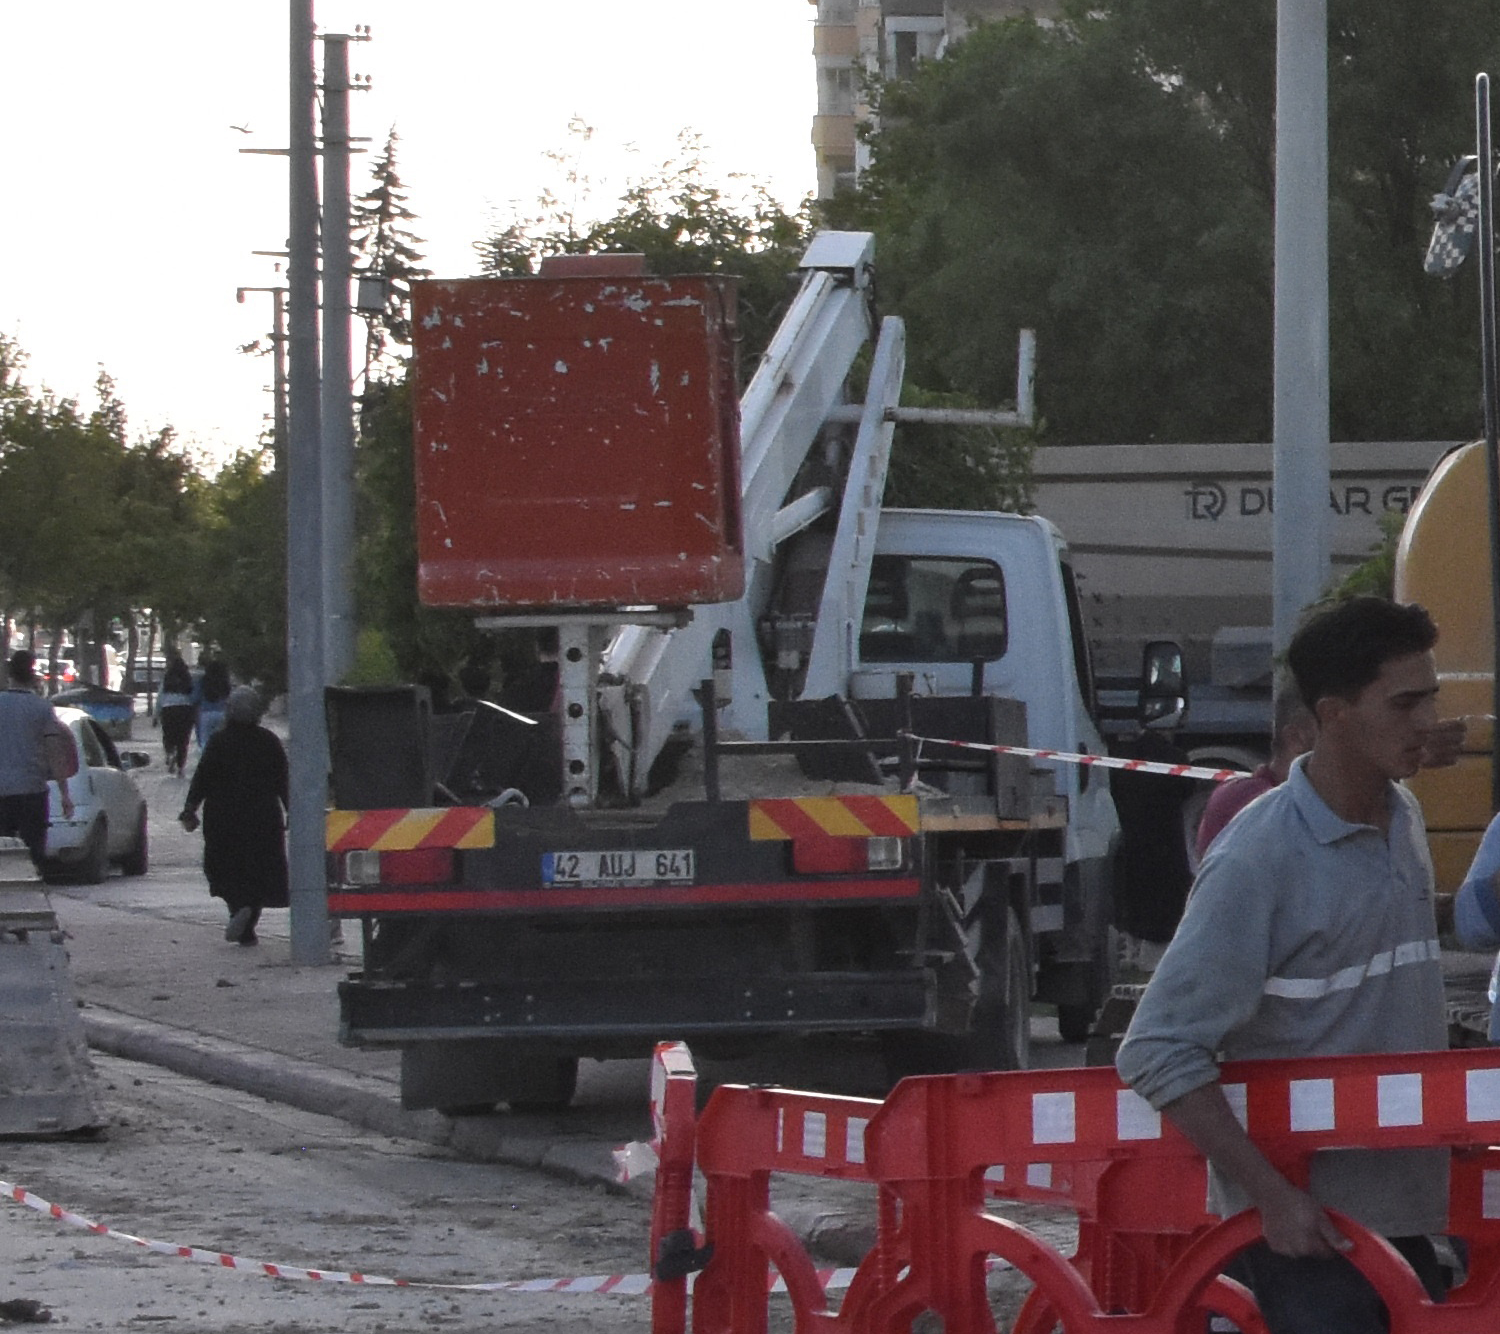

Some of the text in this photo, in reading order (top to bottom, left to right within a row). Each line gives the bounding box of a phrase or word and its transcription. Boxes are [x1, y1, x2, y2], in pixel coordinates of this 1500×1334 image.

[555, 852, 692, 879] 42 AUJ 641
